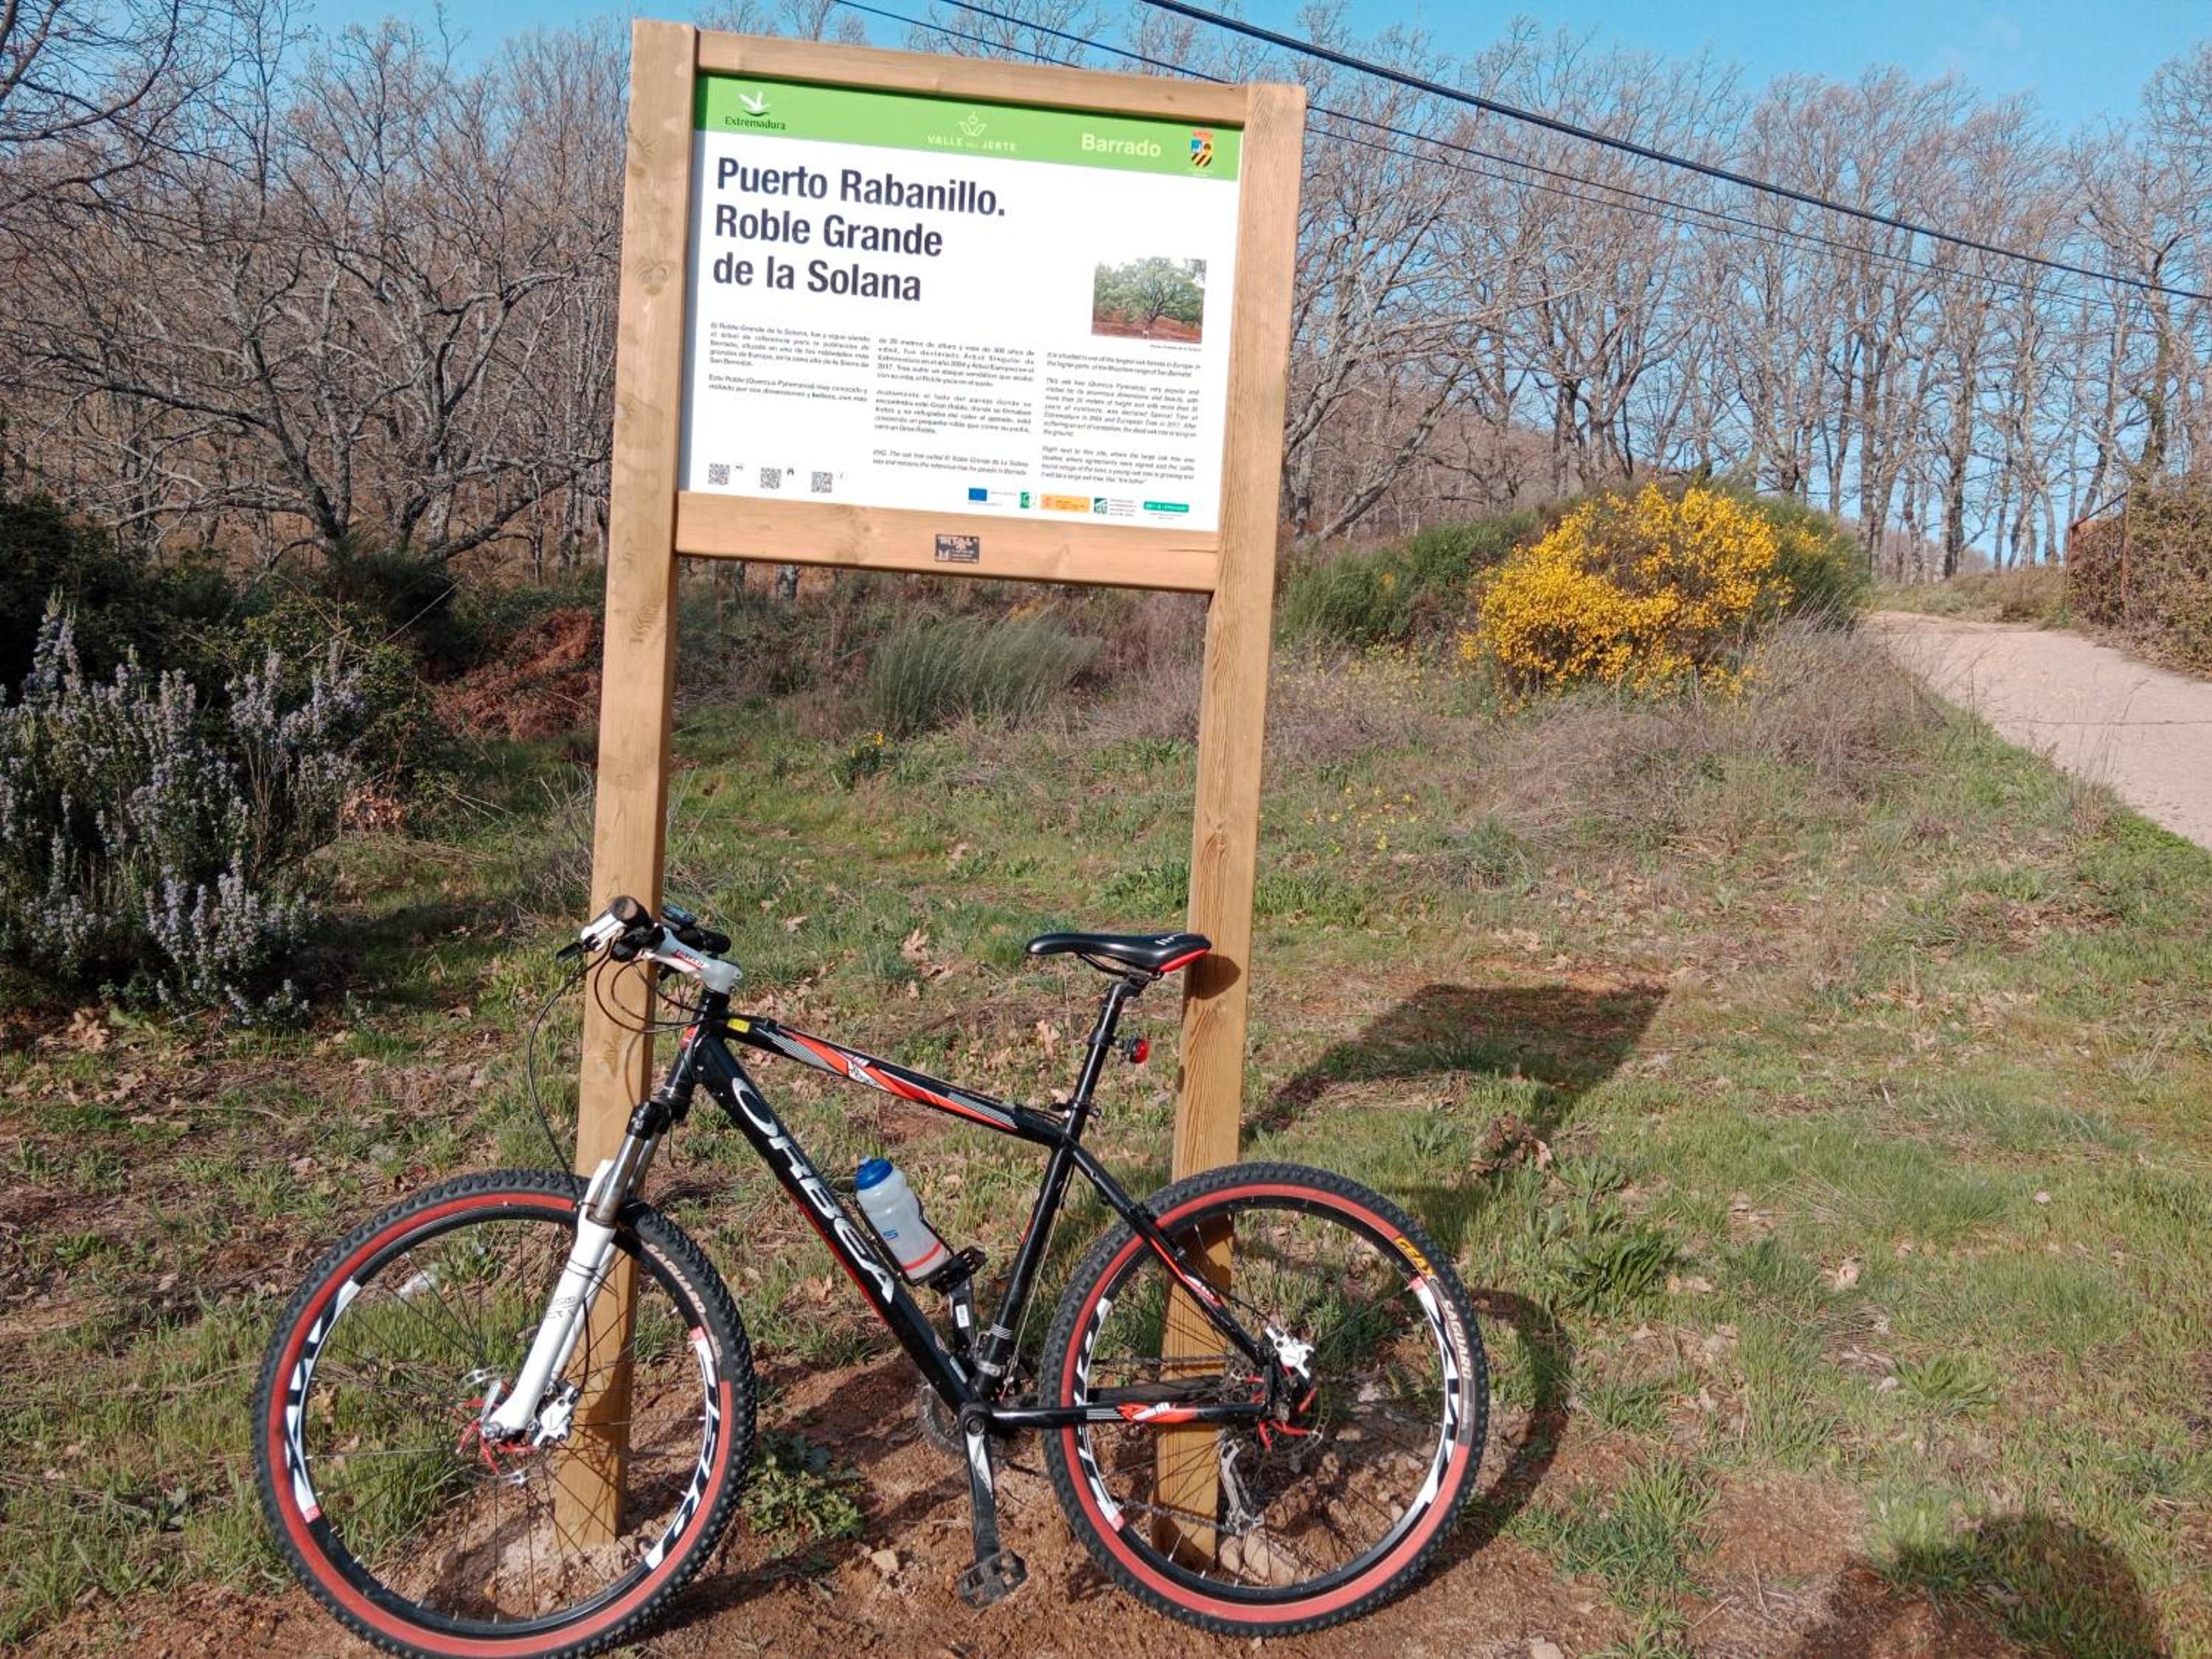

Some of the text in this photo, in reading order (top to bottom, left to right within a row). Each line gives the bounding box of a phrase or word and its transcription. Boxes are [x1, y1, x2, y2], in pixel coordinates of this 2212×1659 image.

[724, 115, 786, 131] Extremadura
[927, 133, 964, 147] VALLE
[981, 140, 1016, 152] JERTE
[1081, 133, 1162, 157] Barrado
[717, 157, 1005, 216] Puerto Rabanillo.
[716, 204, 942, 257] Roble Grande
[713, 252, 921, 301] de la Solana
